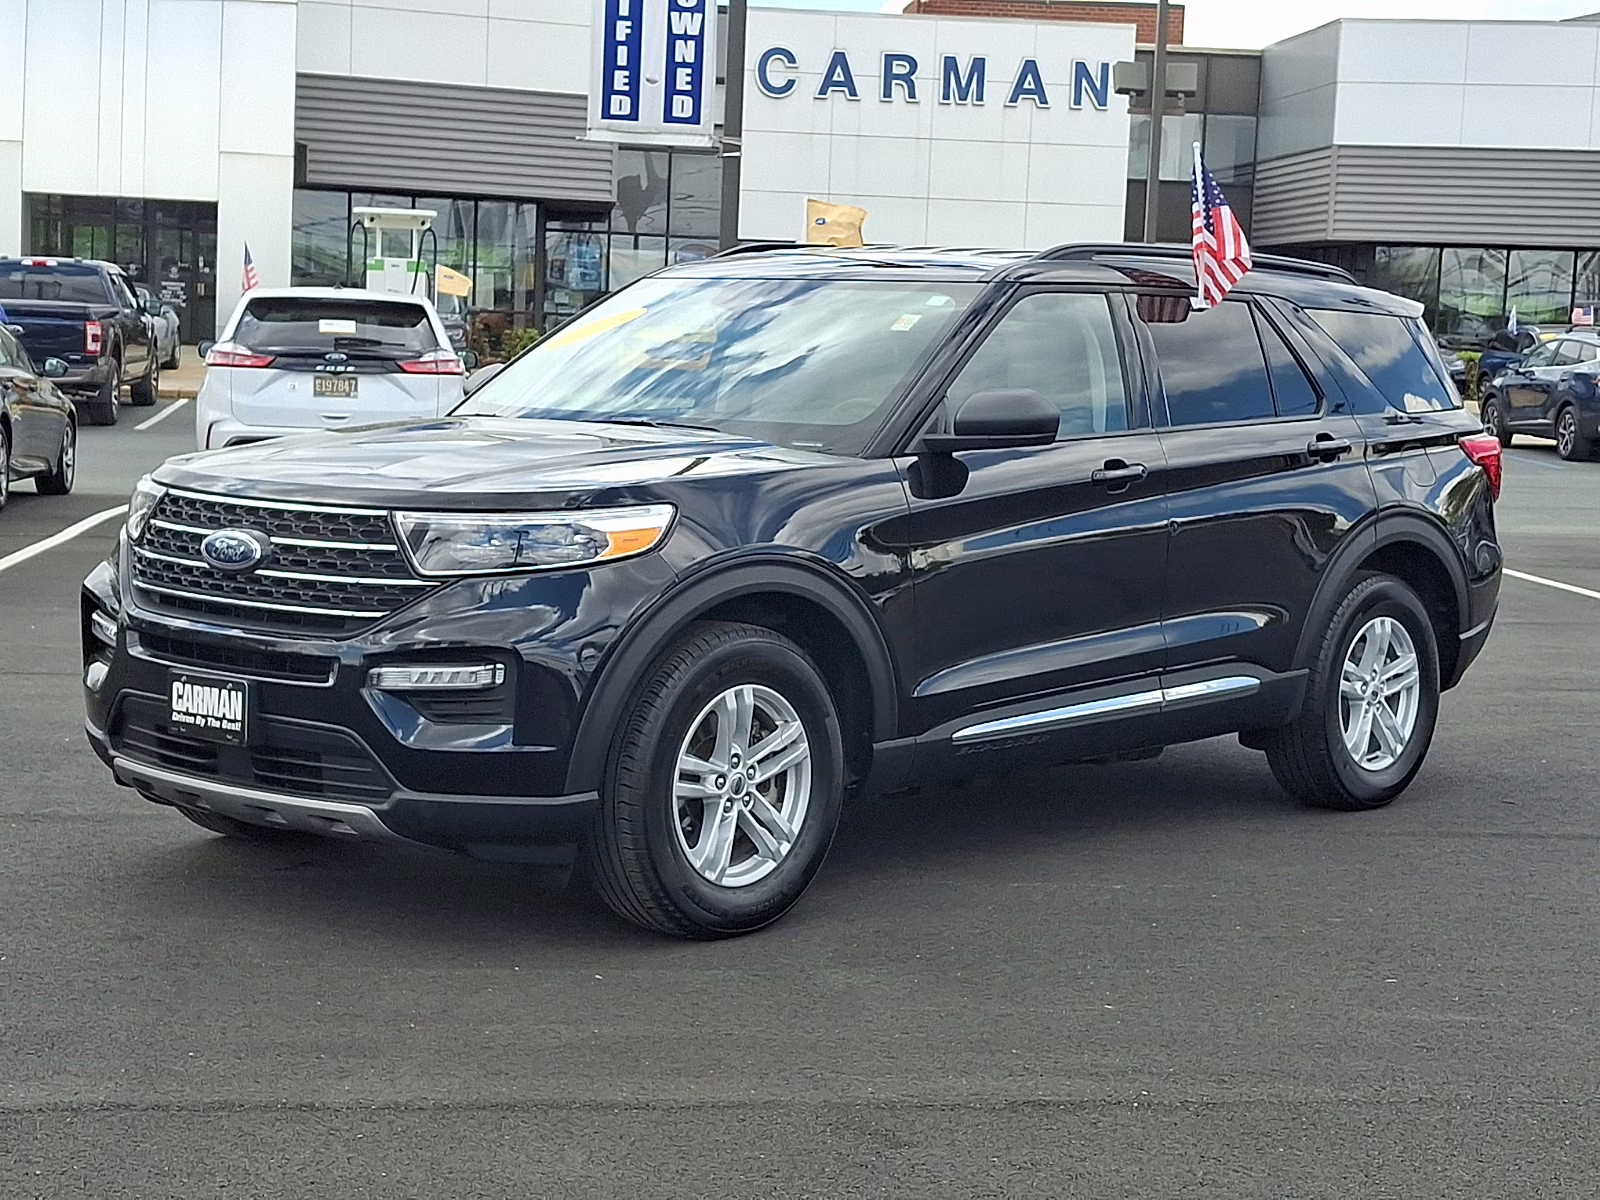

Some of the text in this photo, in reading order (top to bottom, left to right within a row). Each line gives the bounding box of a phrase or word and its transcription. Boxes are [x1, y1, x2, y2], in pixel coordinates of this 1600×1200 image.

[756, 46, 1111, 109] CARMAN
[211, 537, 246, 561] Ford
[172, 681, 243, 721] CARMAN
[172, 711, 195, 724] Driven
[195, 715, 206, 728] By
[206, 717, 221, 729] The
